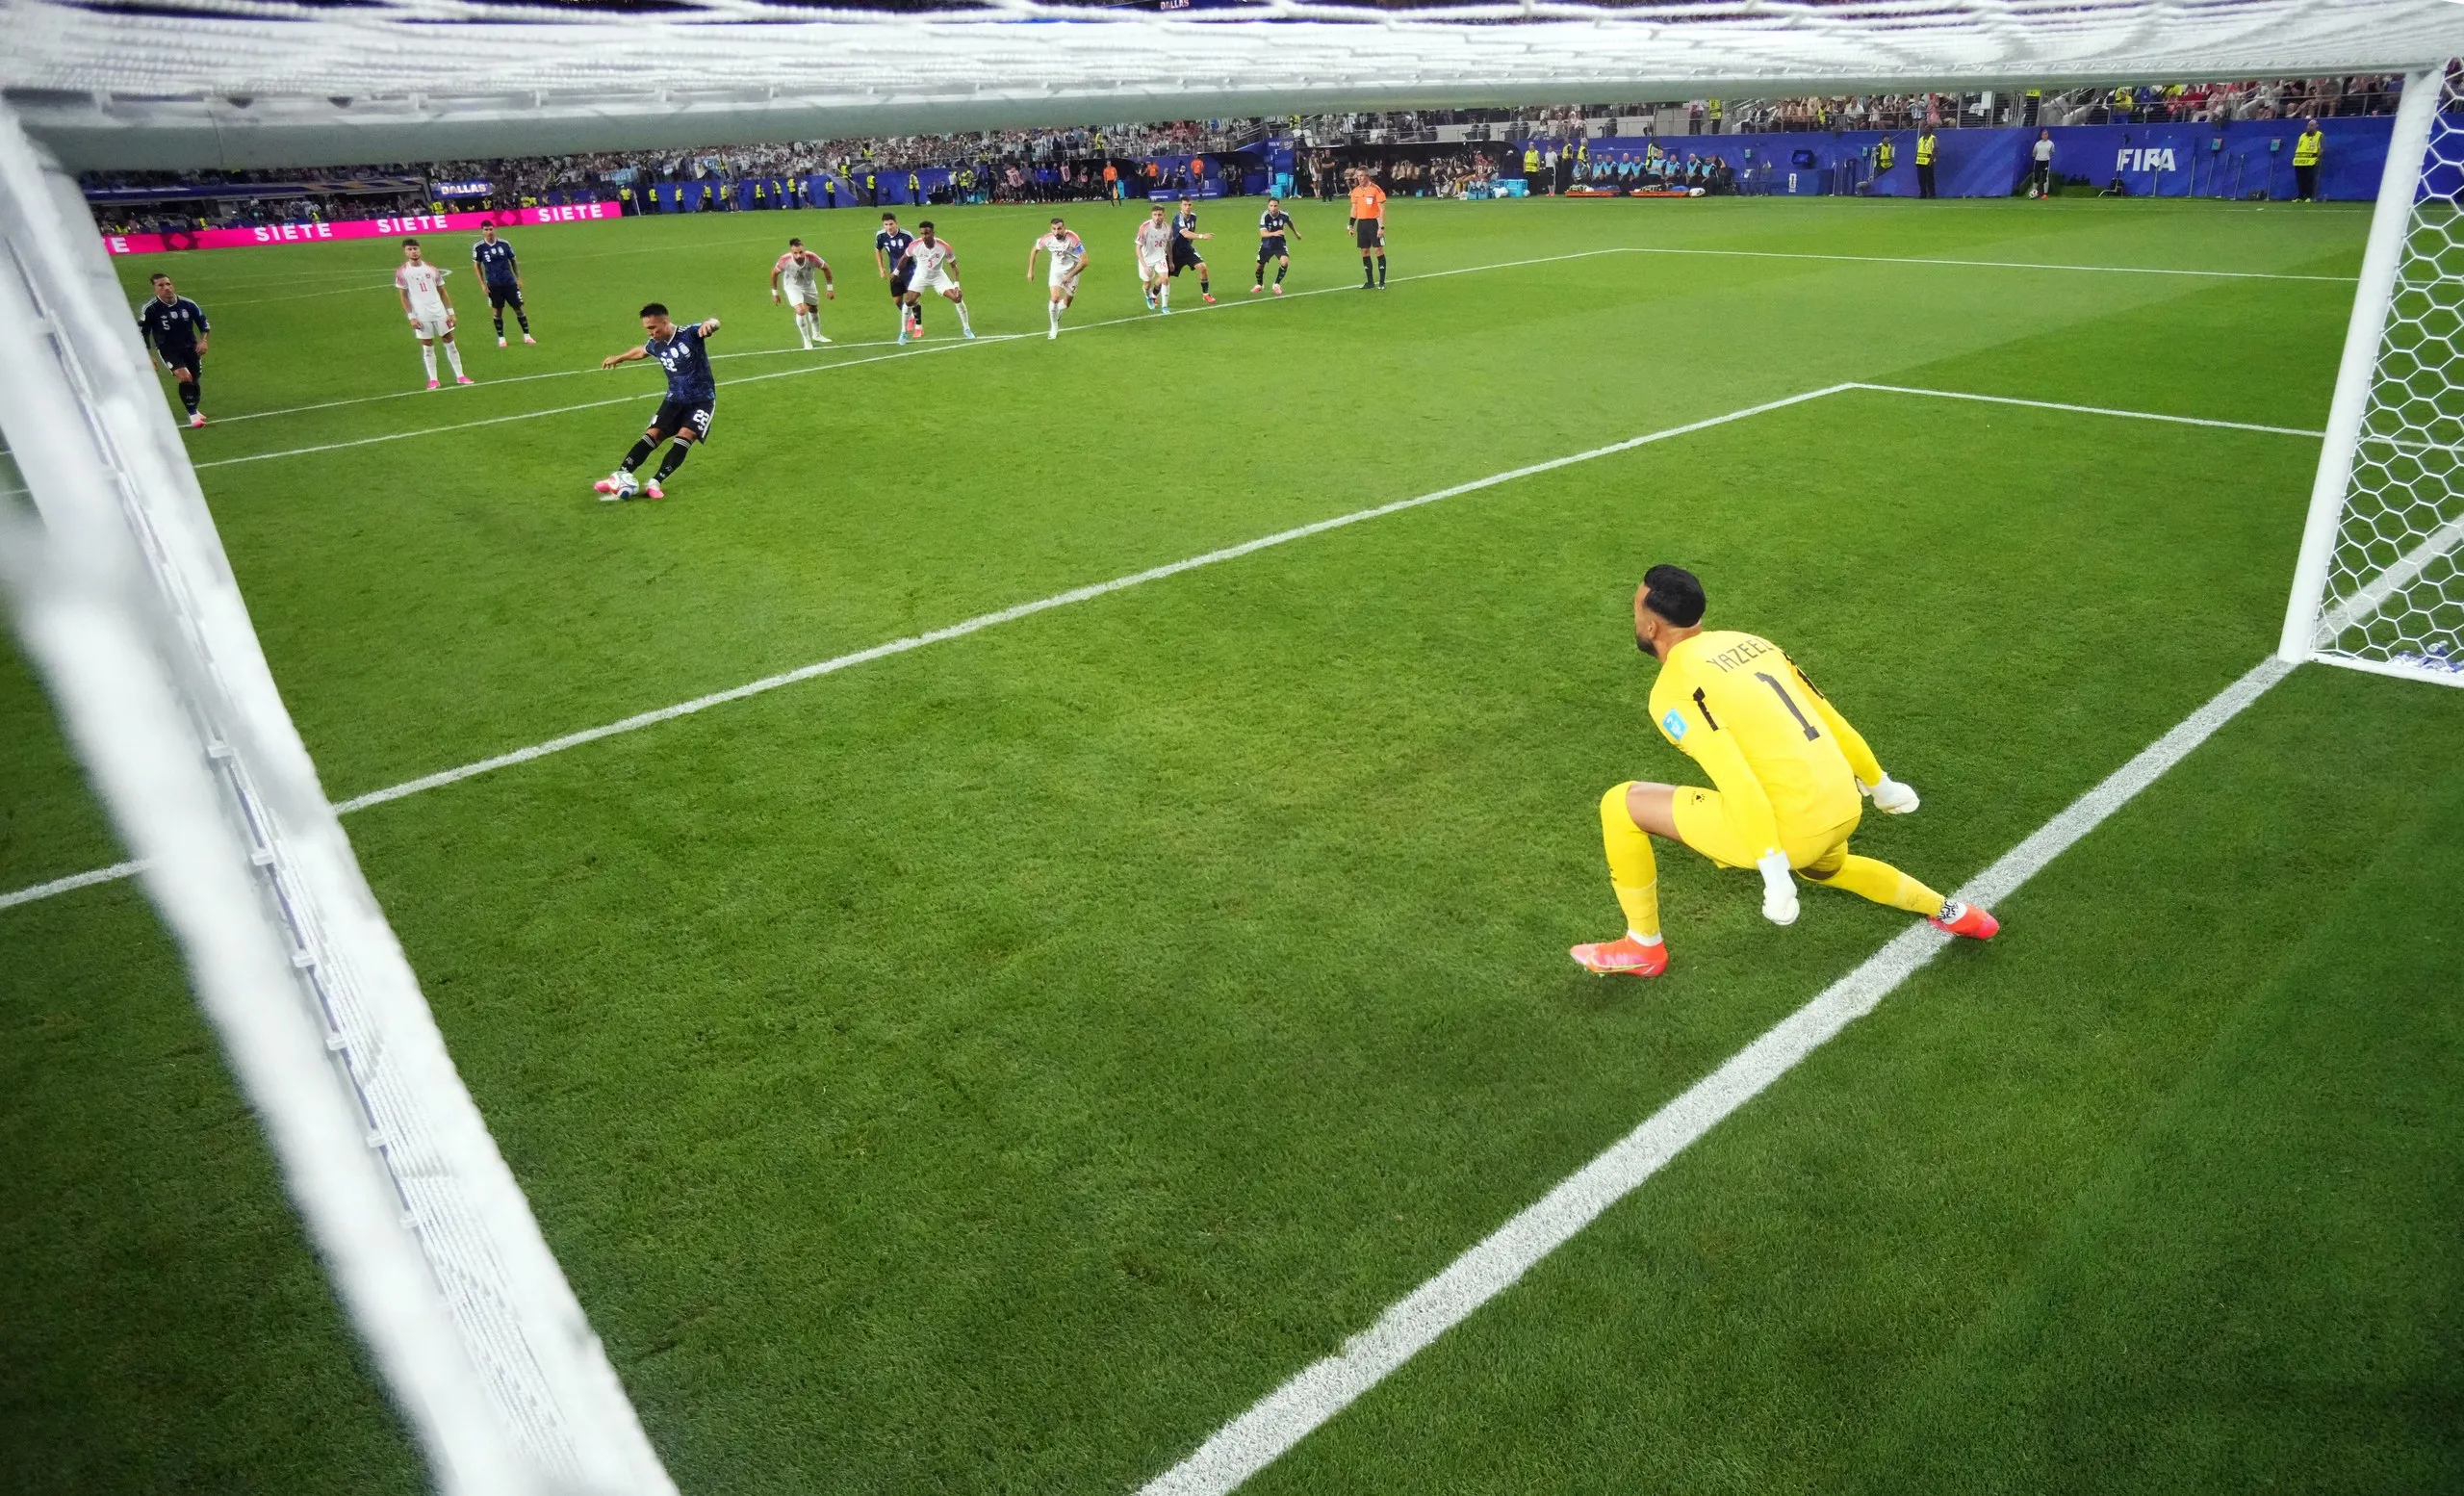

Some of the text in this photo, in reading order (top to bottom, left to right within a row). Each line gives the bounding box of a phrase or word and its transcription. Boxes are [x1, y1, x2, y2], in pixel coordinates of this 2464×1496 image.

[2117, 148, 2176, 171] FIFA
[441, 183, 486, 194] DALLAS
[538, 204, 603, 221] SIETE
[377, 214, 449, 233] SIETE
[254, 222, 333, 242] SIETE
[484, 254, 492, 263] 2
[928, 259, 934, 270] 3
[420, 282, 428, 293] 11
[162, 320, 170, 330] 5
[659, 357, 678, 373] 22
[693, 409, 710, 426] 22
[1754, 671, 1821, 741] 1
